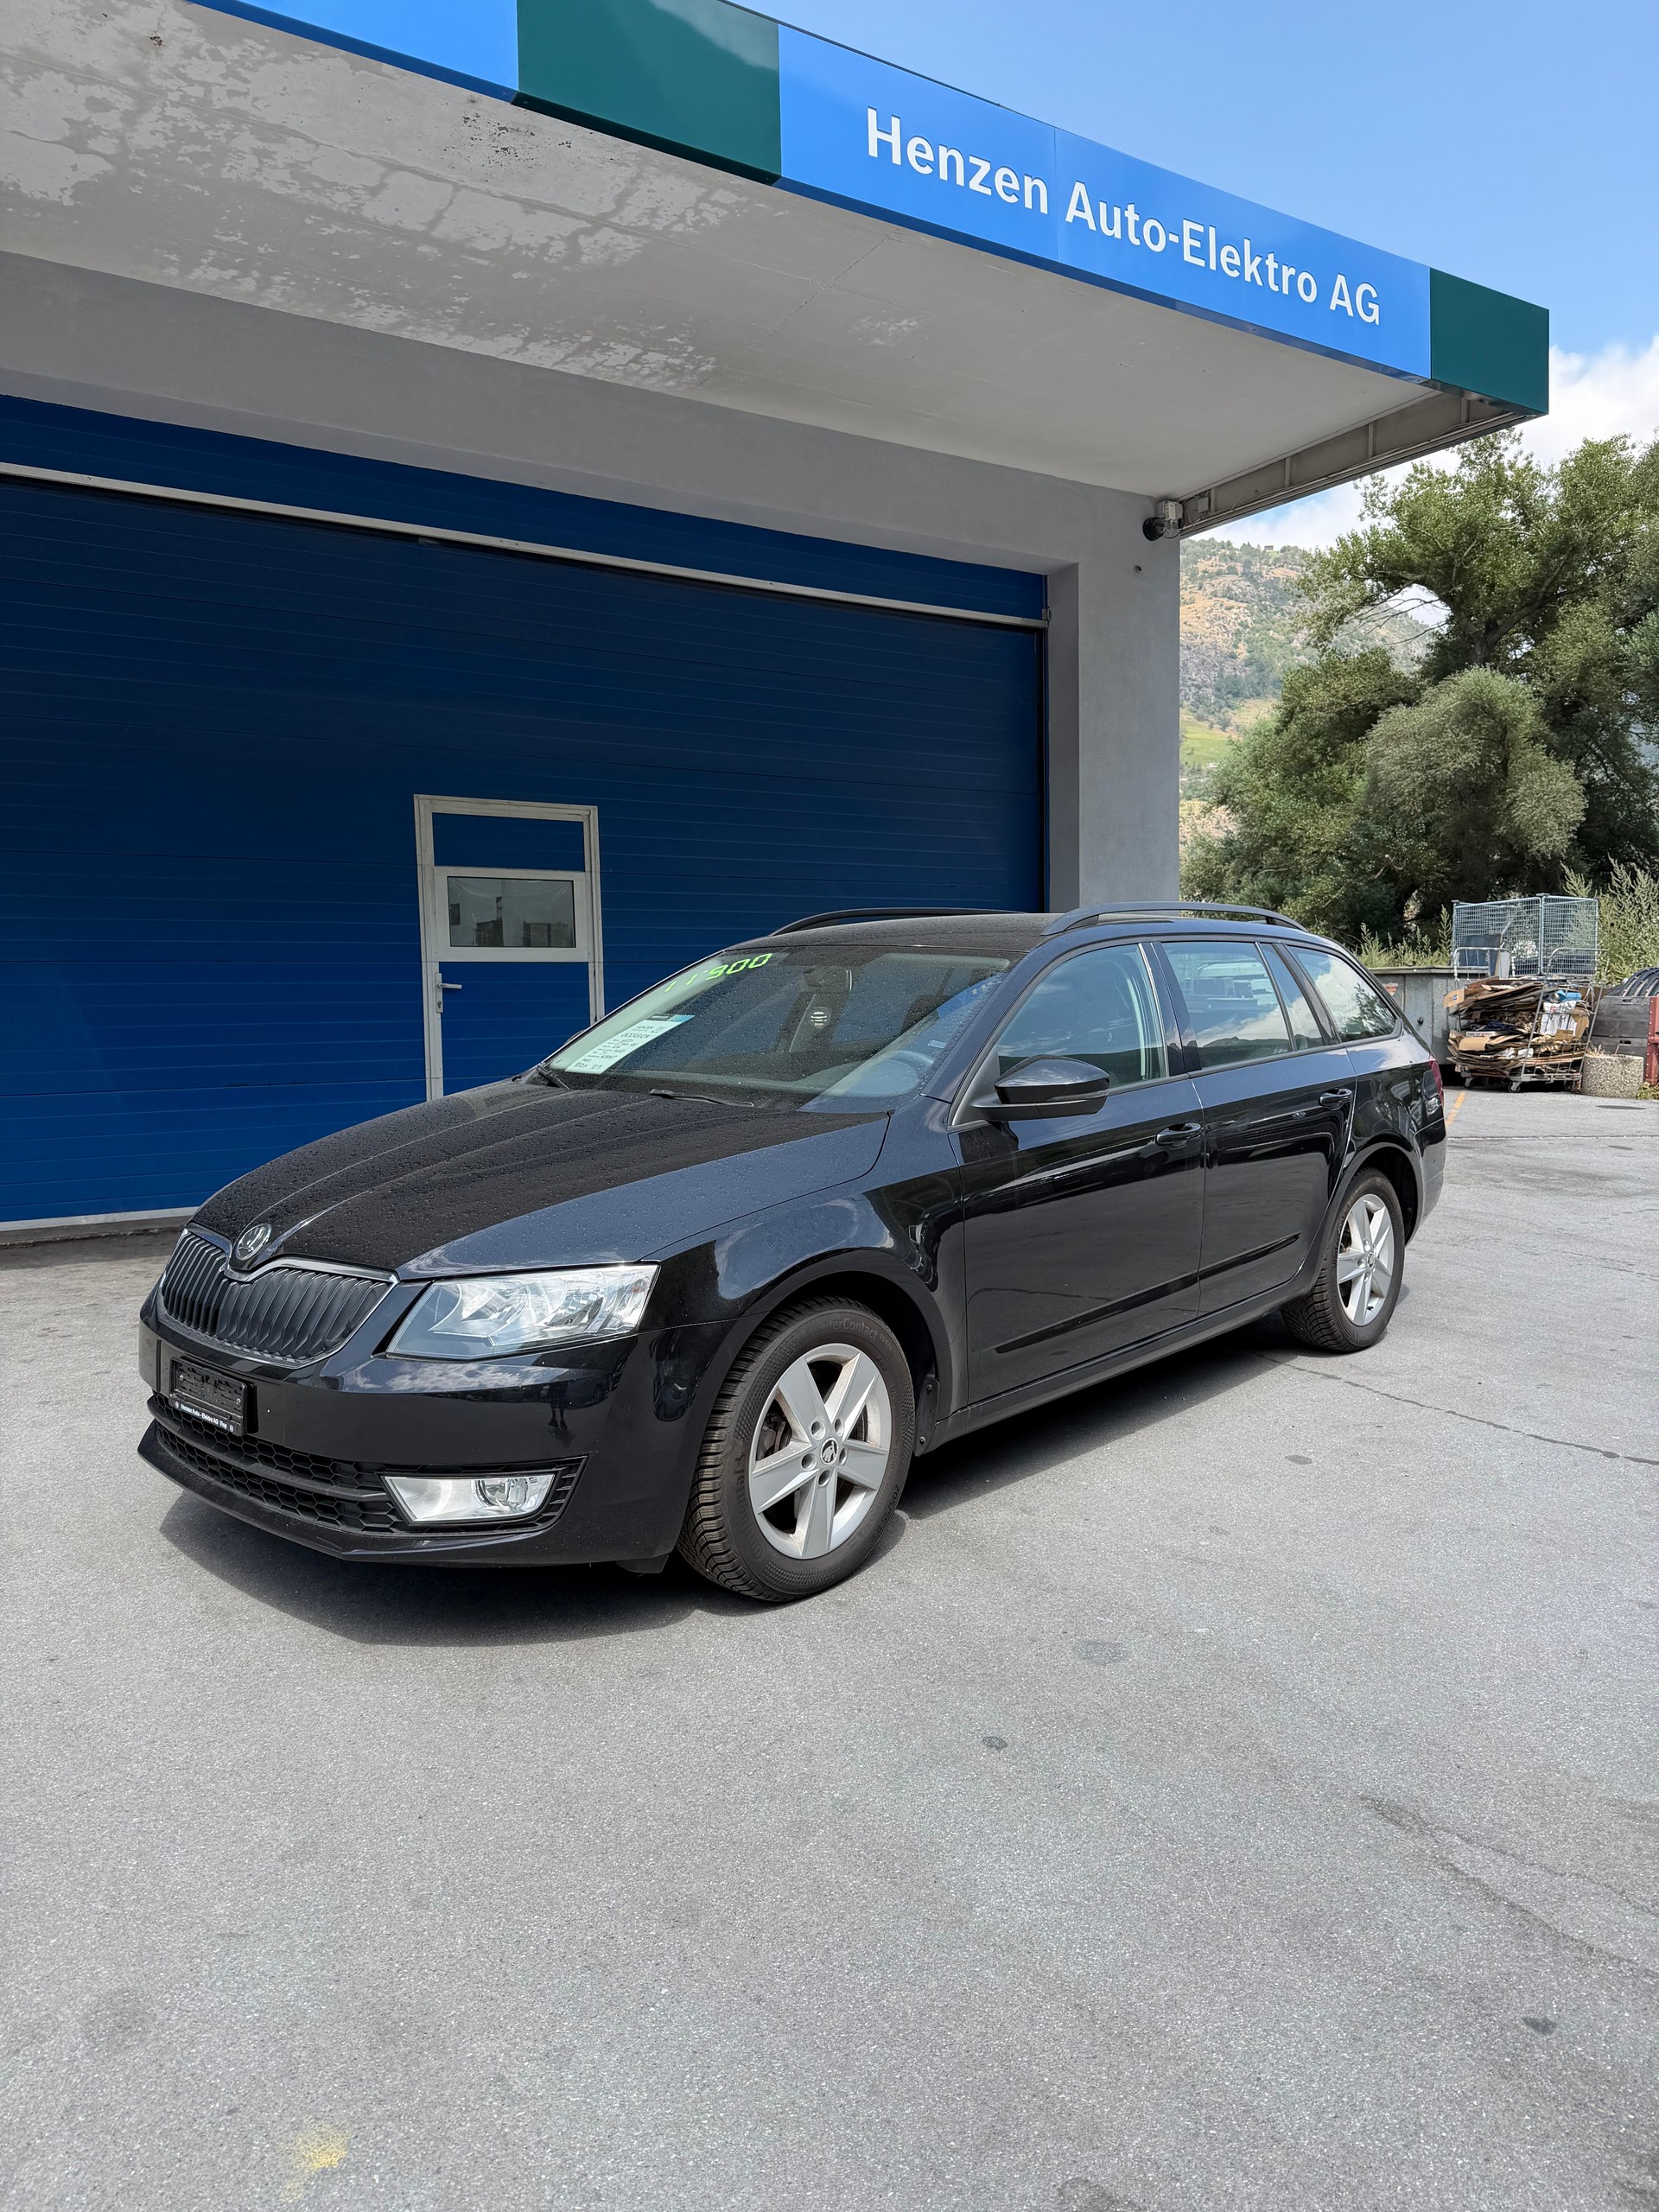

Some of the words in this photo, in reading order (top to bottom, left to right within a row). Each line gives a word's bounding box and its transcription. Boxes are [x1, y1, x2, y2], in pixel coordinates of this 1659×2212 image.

[868, 107, 1048, 215] Henzen
[1065, 181, 1318, 304] Auto-Elektro
[1329, 274, 1380, 326] AG
